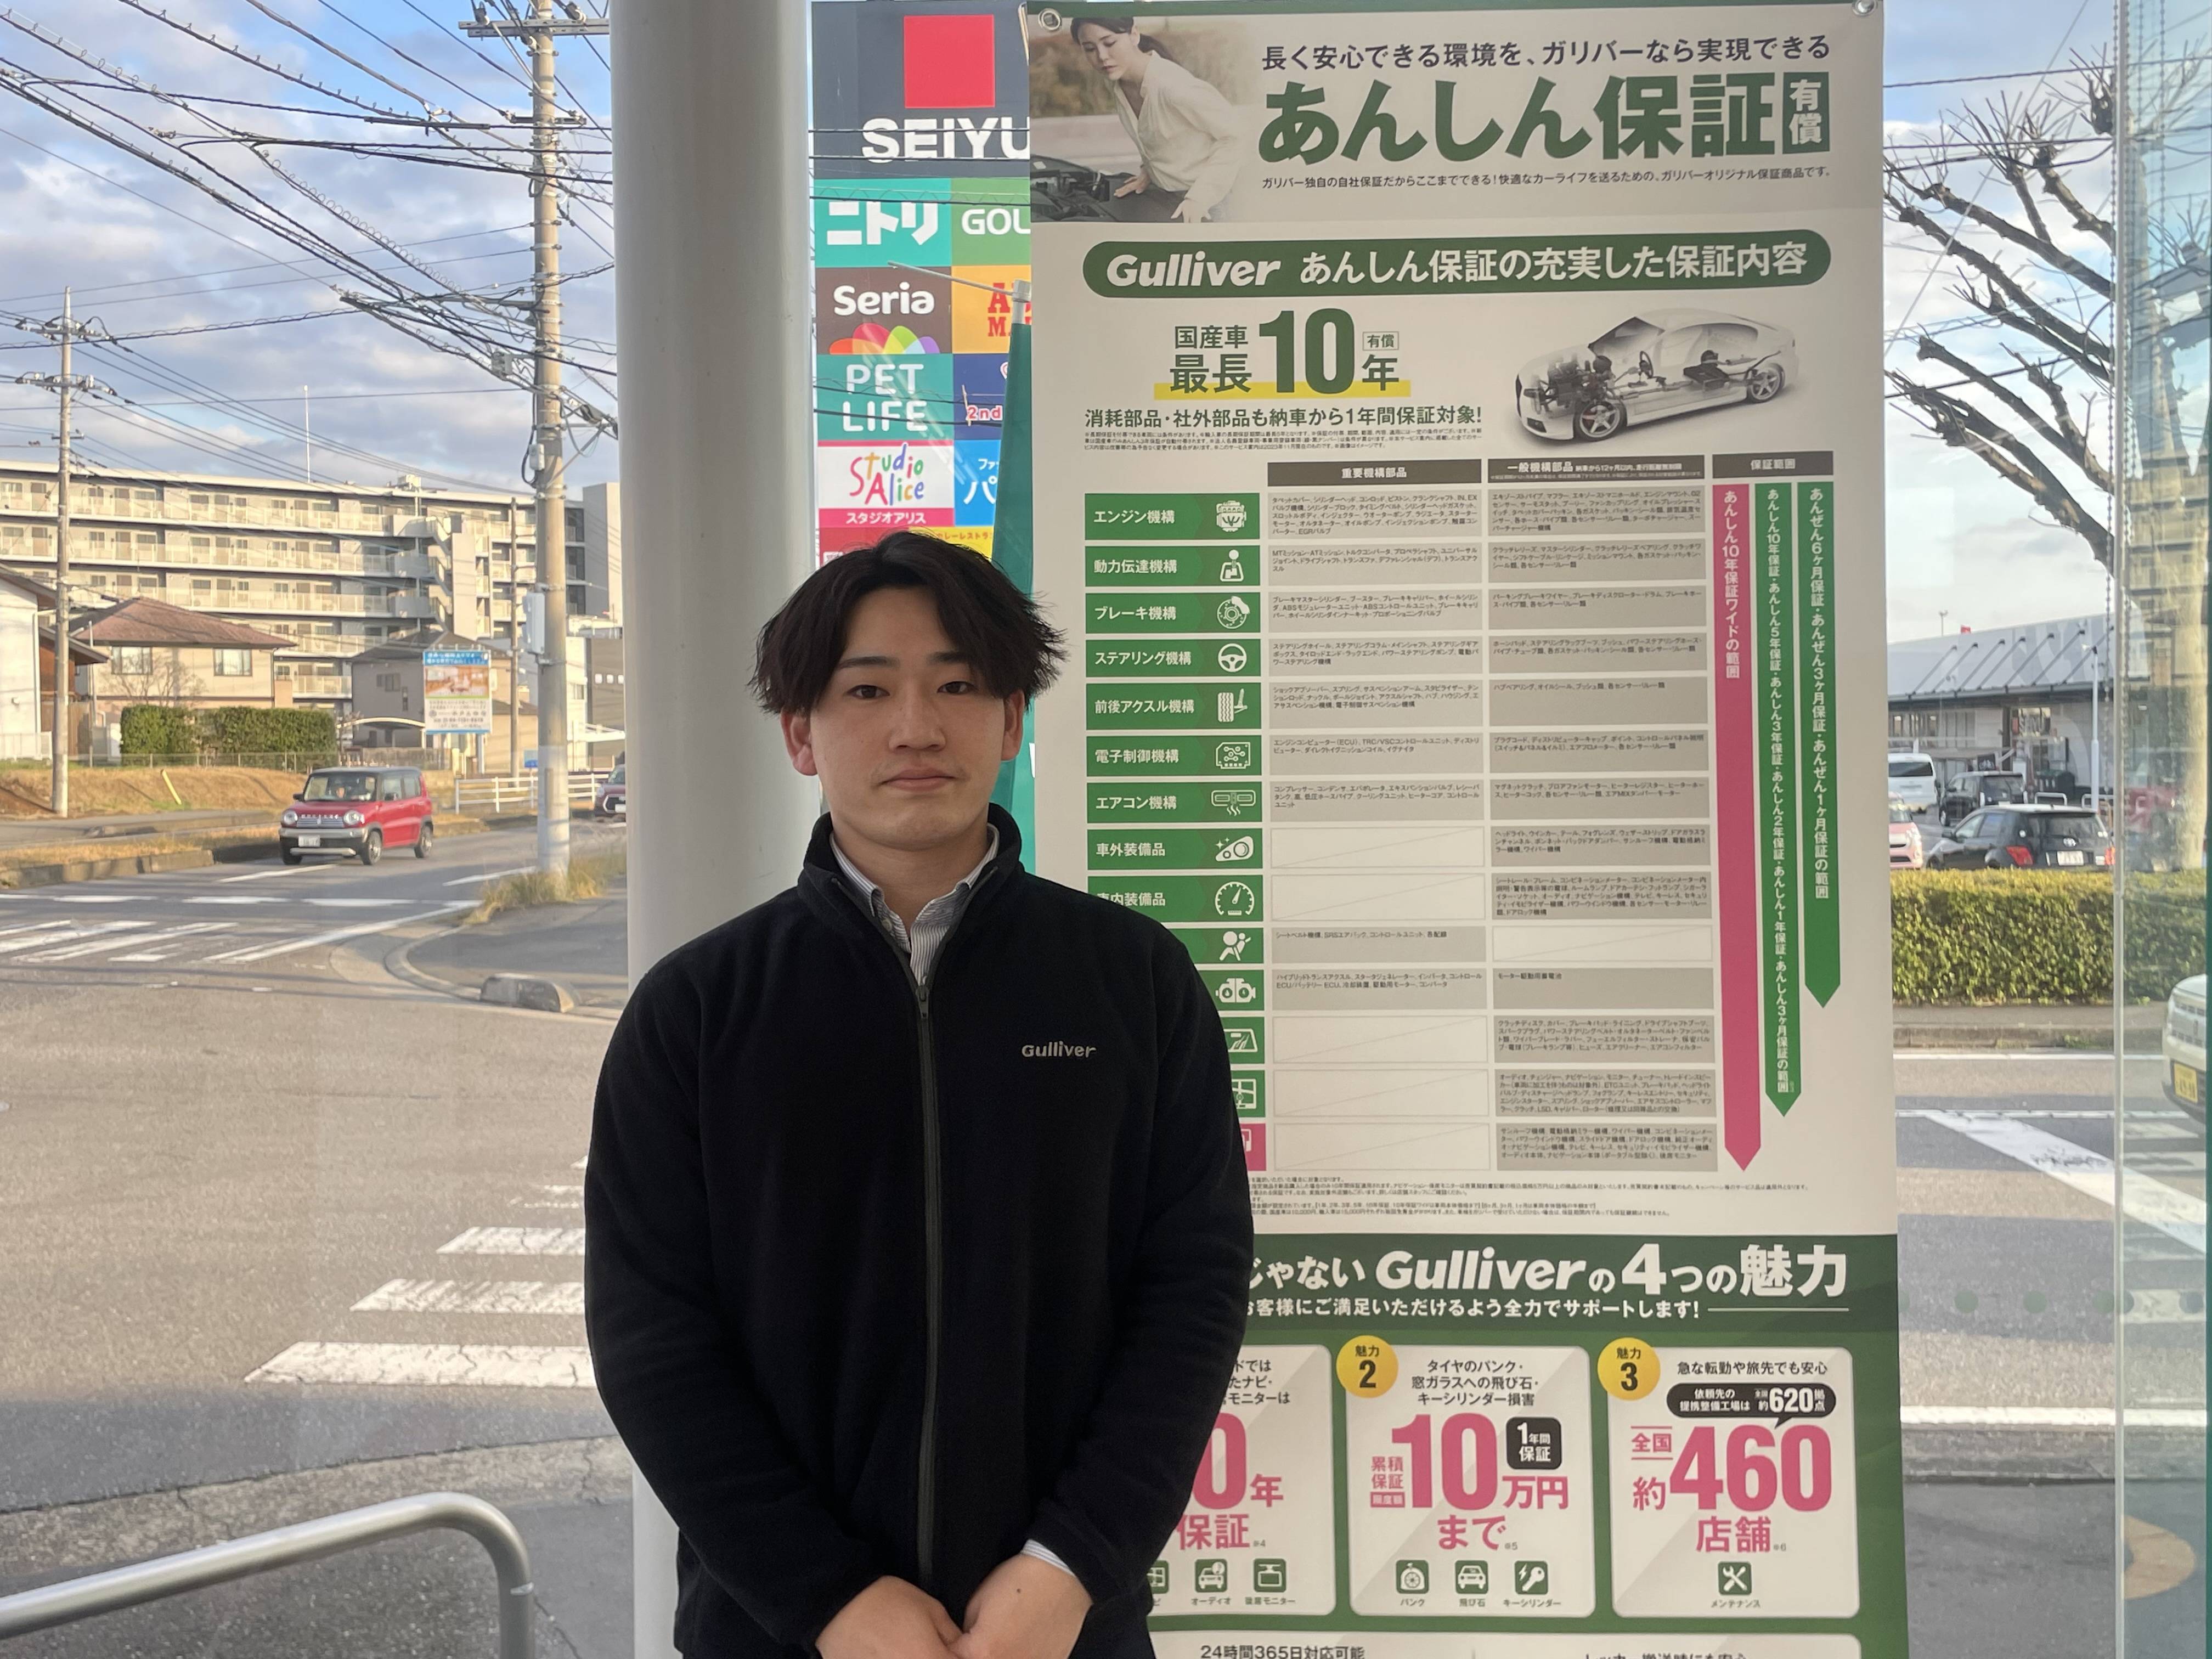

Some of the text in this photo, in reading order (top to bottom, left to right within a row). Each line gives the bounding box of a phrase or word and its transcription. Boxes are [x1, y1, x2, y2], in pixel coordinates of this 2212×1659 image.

[1261, 35, 1831, 70] 長く安心できる環境を、ガリバーなら実現できる
[1258, 71, 1822, 166] あんしん保証 有償
[861, 117, 1030, 163] SEIYU
[827, 201, 938, 245] ニトリ
[962, 208, 1031, 235] GOL
[1106, 240, 1807, 287] Gulliver あんしん保証の充実した保証内容
[833, 282, 935, 315] Seria
[1174, 325, 1249, 349] 国産車
[1367, 334, 1395, 348] 有償
[1169, 308, 1400, 395] 最長 10 年
[847, 364, 924, 395] PET
[842, 400, 928, 432] LIFE
[967, 405, 1003, 421] 2nd
[1085, 405, 1482, 428] 消耗部品・社外部品も納車から1年間保証対象!
[1341, 467, 1407, 479] 重要機構部品
[1507, 461, 1573, 473] 一般機構部品
[1750, 458, 1796, 471] 保証範囲
[865, 472, 924, 506] Alice
[845, 511, 927, 525] スタジオアリス
[1093, 509, 1175, 524] エンジン機構
[1093, 558, 1177, 574] 動力伝達機構
[1094, 606, 1176, 621] ブレーキ機構
[1094, 650, 1192, 666] ステアリング機構
[1094, 699, 1195, 714] 前後アクスル機構
[1095, 749, 1180, 764] 電子制御機構
[1096, 795, 1177, 810] エアコン機構
[1096, 842, 1166, 857] 車外装備品
[1022, 1041, 1097, 1058] Gulliver
[1375, 1246, 1587, 1290] Gulliver
[1589, 1243, 1847, 1297] の4つの魅力
[1355, 1345, 1379, 1357] 魅力
[1616, 1347, 1641, 1359] 魅力
[1359, 1360, 1376, 1389] 2
[1620, 1362, 1638, 1391] 3
[1223, 1392, 1290, 1405] モニターは
[1417, 1392, 1534, 1406] キーシリンダー損害
[1769, 1387, 1813, 1413] 620
[1516, 1421, 1551, 1445] 1年間
[1631, 1433, 1672, 1453] 全国
[1392, 1413, 1568, 1510] 10 万円
[1519, 1446, 1551, 1462] 保証
[1371, 1456, 1403, 1472] 累積
[1633, 1424, 1832, 1512] 約 460
[1371, 1474, 1403, 1489] 保証
[1250, 1474, 1283, 1508] 年
[1177, 1514, 1250, 1550] 保証
[1437, 1514, 1506, 1550] まで
[1696, 1516, 1771, 1553] 店舗
[1190, 1596, 1231, 1605] オーディオ
[1503, 1599, 1561, 1607] キーシリンダー
[1711, 1599, 1761, 1608] メンテナンス
[1200, 1645, 1365, 1659] 24時間365日対応可能
